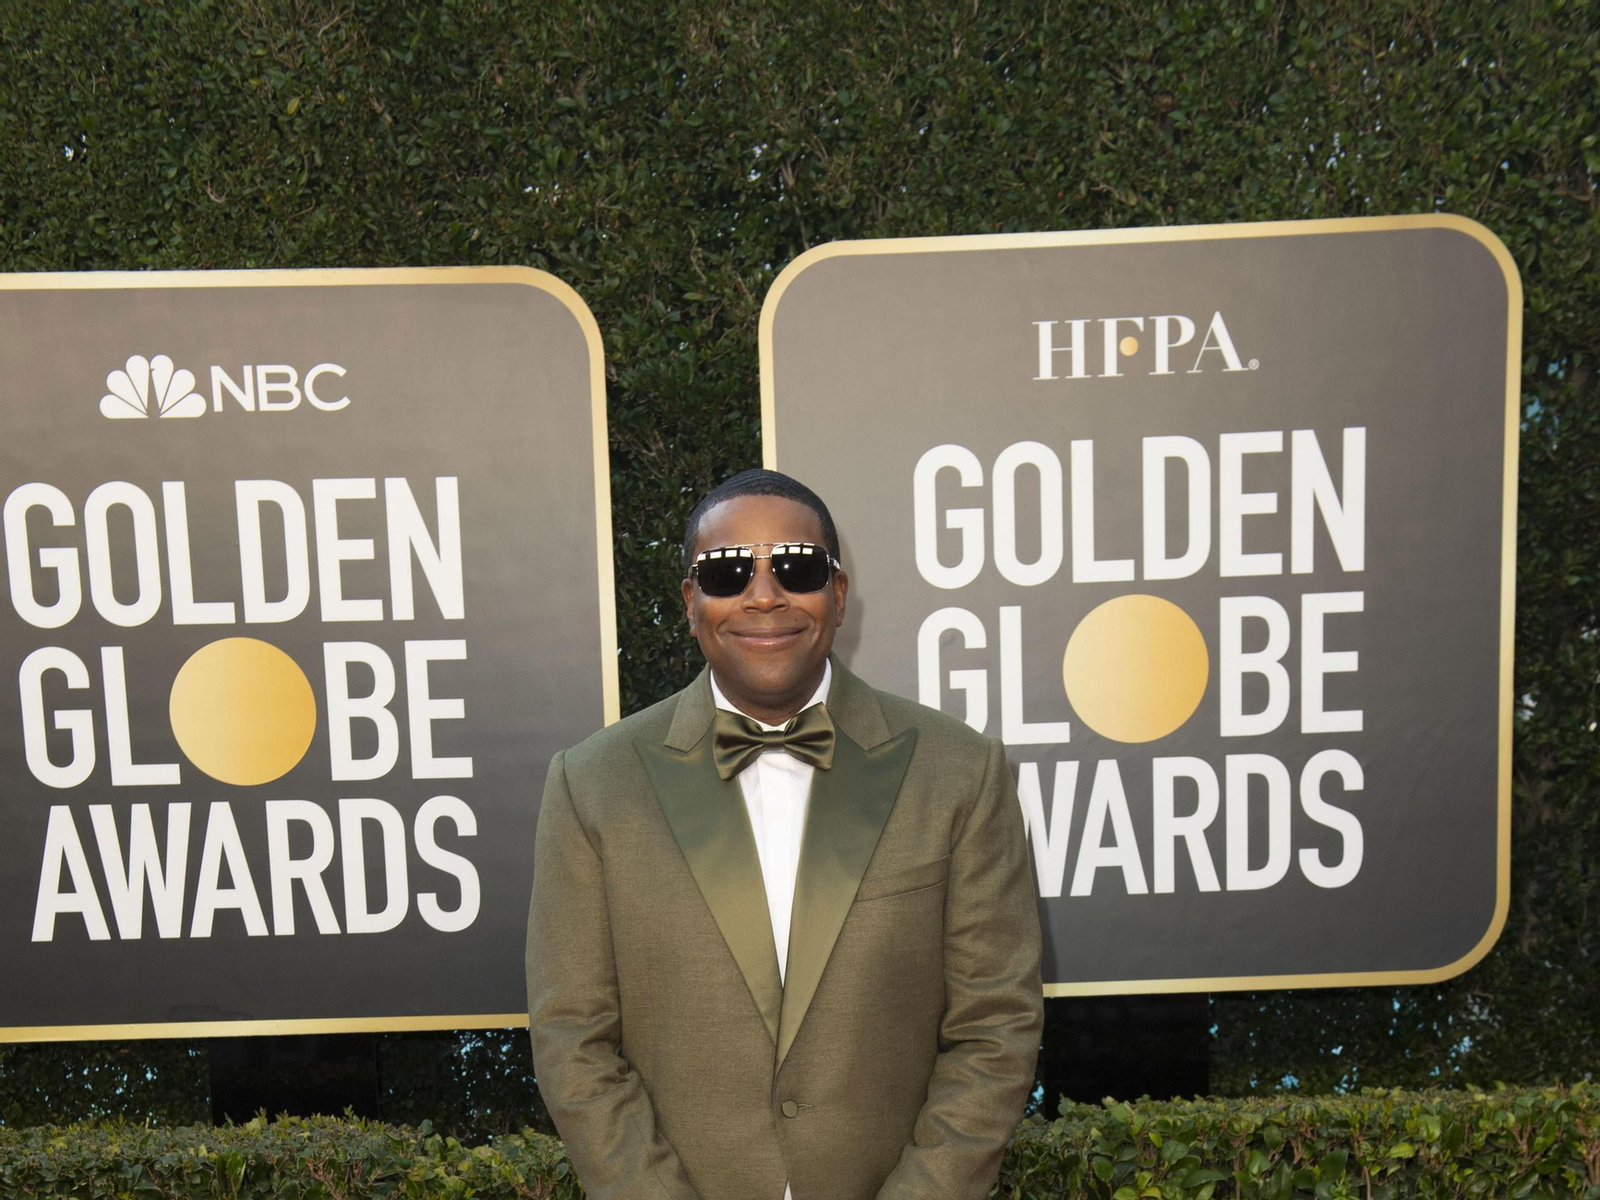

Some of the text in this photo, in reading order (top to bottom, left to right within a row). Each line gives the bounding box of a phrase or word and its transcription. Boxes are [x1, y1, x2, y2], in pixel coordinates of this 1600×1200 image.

[211, 363, 351, 412] NBC
[3, 477, 465, 629] GOLDEN
[913, 427, 1366, 590] GOLDEN
[19, 637, 474, 789] GLOBE
[917, 592, 1365, 746] GLOBE
[31, 796, 481, 942] AWARDS
[1018, 749, 1365, 898] WARDS
